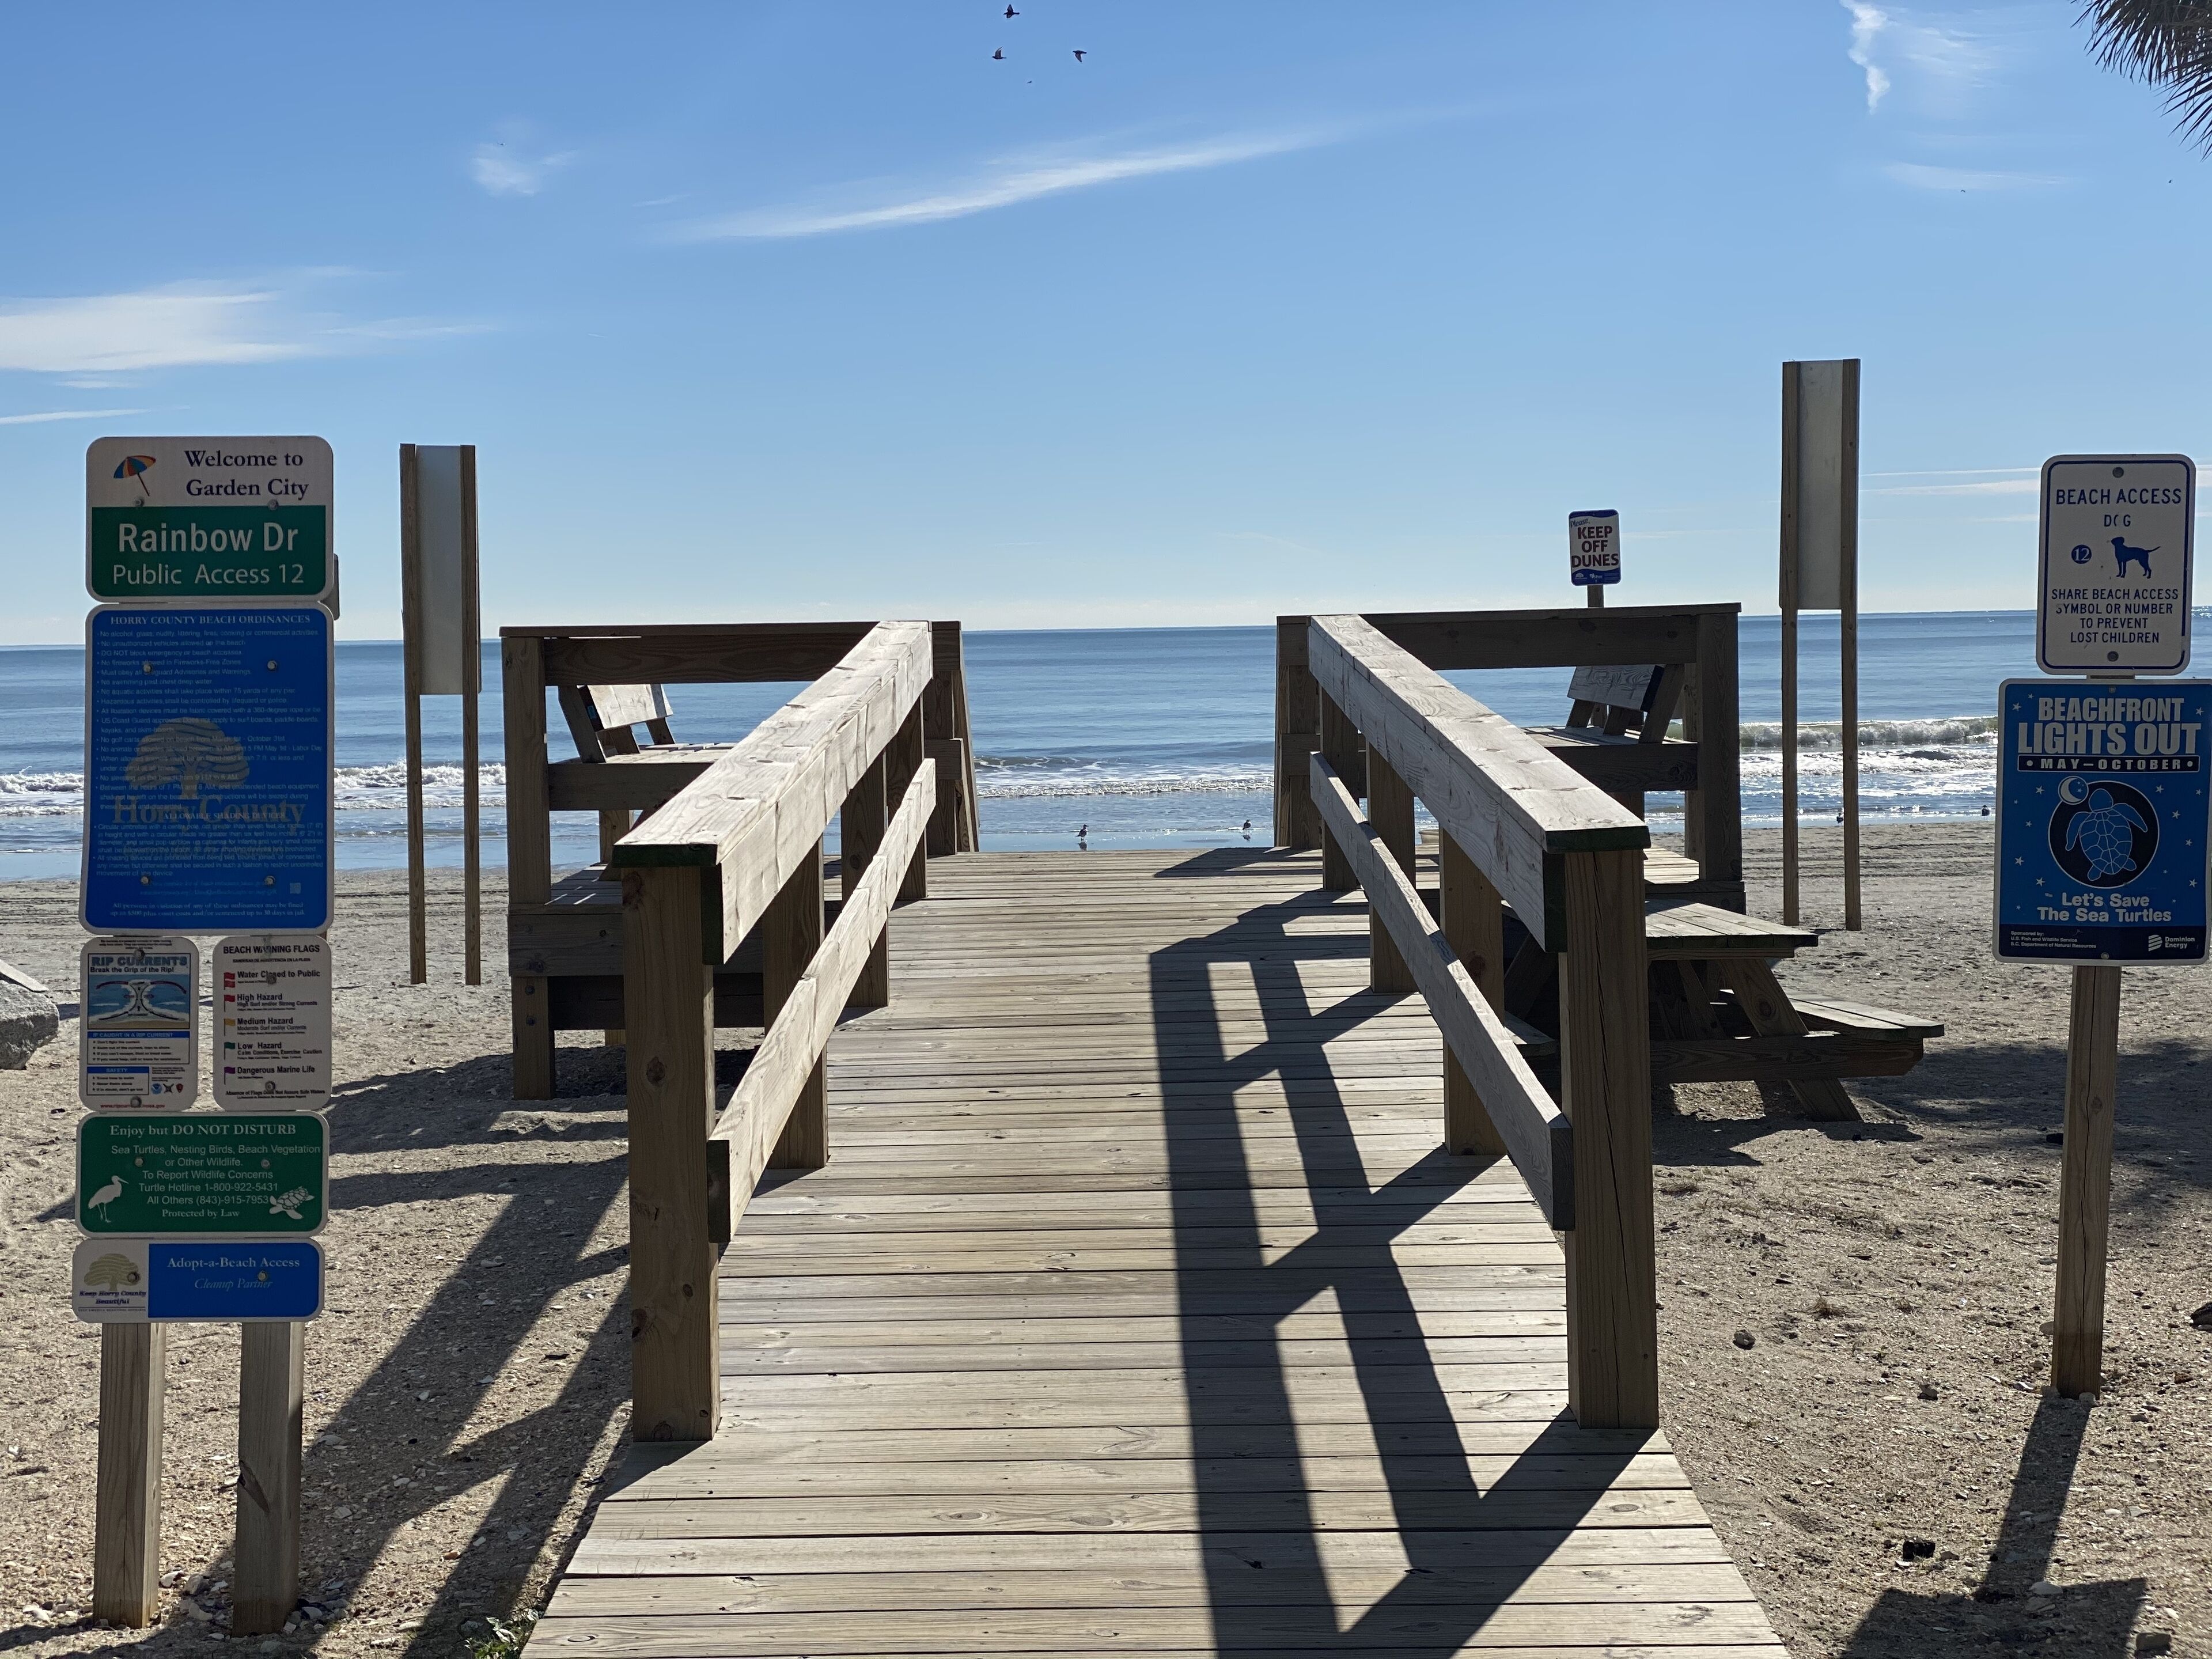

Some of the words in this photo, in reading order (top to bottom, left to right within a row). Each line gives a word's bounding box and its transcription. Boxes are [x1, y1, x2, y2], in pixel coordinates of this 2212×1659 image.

[184, 450, 276, 467] Welcome
[285, 452, 304, 467] to
[186, 479, 260, 496] Garden
[268, 478, 309, 500] City
[2056, 489, 2110, 505] BEACH
[2116, 488, 2181, 504] ACCESS
[119, 522, 252, 552] Rainbow
[263, 522, 298, 551] Dr
[1578, 525, 1612, 539] KEEP
[1581, 540, 1608, 552] OFF
[1571, 554, 1619, 567] DUNES
[2074, 548, 2089, 561] 12
[113, 564, 181, 584] Public
[194, 563, 270, 584] Access
[279, 564, 304, 583] 12
[2051, 589, 2088, 600] SHARE
[2092, 589, 2130, 600] BEACH
[2134, 589, 2179, 600] ACCESS
[2056, 603, 2101, 614] SYMBOL
[2106, 603, 2121, 614] OR
[2124, 603, 2173, 614] NUMBER
[111, 616, 147, 625] HORRY
[150, 616, 195, 624] COUNTY
[199, 615, 235, 624] BEACH
[238, 614, 310, 623] ORDINANCES
[2080, 618, 2093, 628] TO
[2097, 618, 2148, 628] PREVENT
[2070, 632, 2097, 643] LOST
[2102, 632, 2160, 643] CHILDREN
[2038, 698, 2184, 722] BEACHFRONT
[2018, 722, 2126, 755] LIGHTS
[2134, 722, 2202, 755] OUT
[2062, 893, 2103, 907] Let's
[2109, 893, 2150, 907] Save
[2036, 907, 2070, 922] The
[2075, 908, 2109, 922] Sea
[2115, 908, 2172, 922] Turtles
[224, 946, 251, 954] BEACH
[293, 945, 320, 953] FLAGS
[92, 957, 113, 966] RIP
[237, 994, 255, 1002] High
[237, 1067, 275, 1075] Dangerous
[109, 1125, 145, 1138] Enjoy
[149, 1125, 168, 1135] but
[173, 1124, 194, 1135] DO
[197, 1124, 230, 1135] NOT
[233, 1124, 296, 1135] DISTURB
[111, 1146, 130, 1154] Sea
[171, 1146, 206, 1156] Nesting
[209, 1145, 235, 1154] Birds,
[238, 1145, 268, 1153] Beach
[271, 1145, 320, 1156] Vegetation
[177, 1158, 204, 1166] Other
[207, 1158, 243, 1166] Wildlife.
[142, 1171, 154, 1179] To
[157, 1171, 188, 1181] Report
[191, 1171, 225, 1179] Wildlife
[228, 1171, 273, 1179] Concerns
[139, 1183, 165, 1191] Turtle
[168, 1183, 201, 1192] Hotline
[204, 1183, 278, 1191] 1-800-922-5431
[147, 1196, 158, 1205] All
[161, 1196, 193, 1205] Others
[196, 1195, 268, 1206] (843)-915-7953
[162, 1209, 204, 1218] Protected
[207, 1209, 218, 1219] by
[221, 1209, 240, 1217] Law
[167, 1258, 256, 1270] Adopt-a-Beach
[260, 1257, 300, 1267] Access
[194, 1278, 234, 1291] Cleanup
[237, 1278, 273, 1289] Partner
